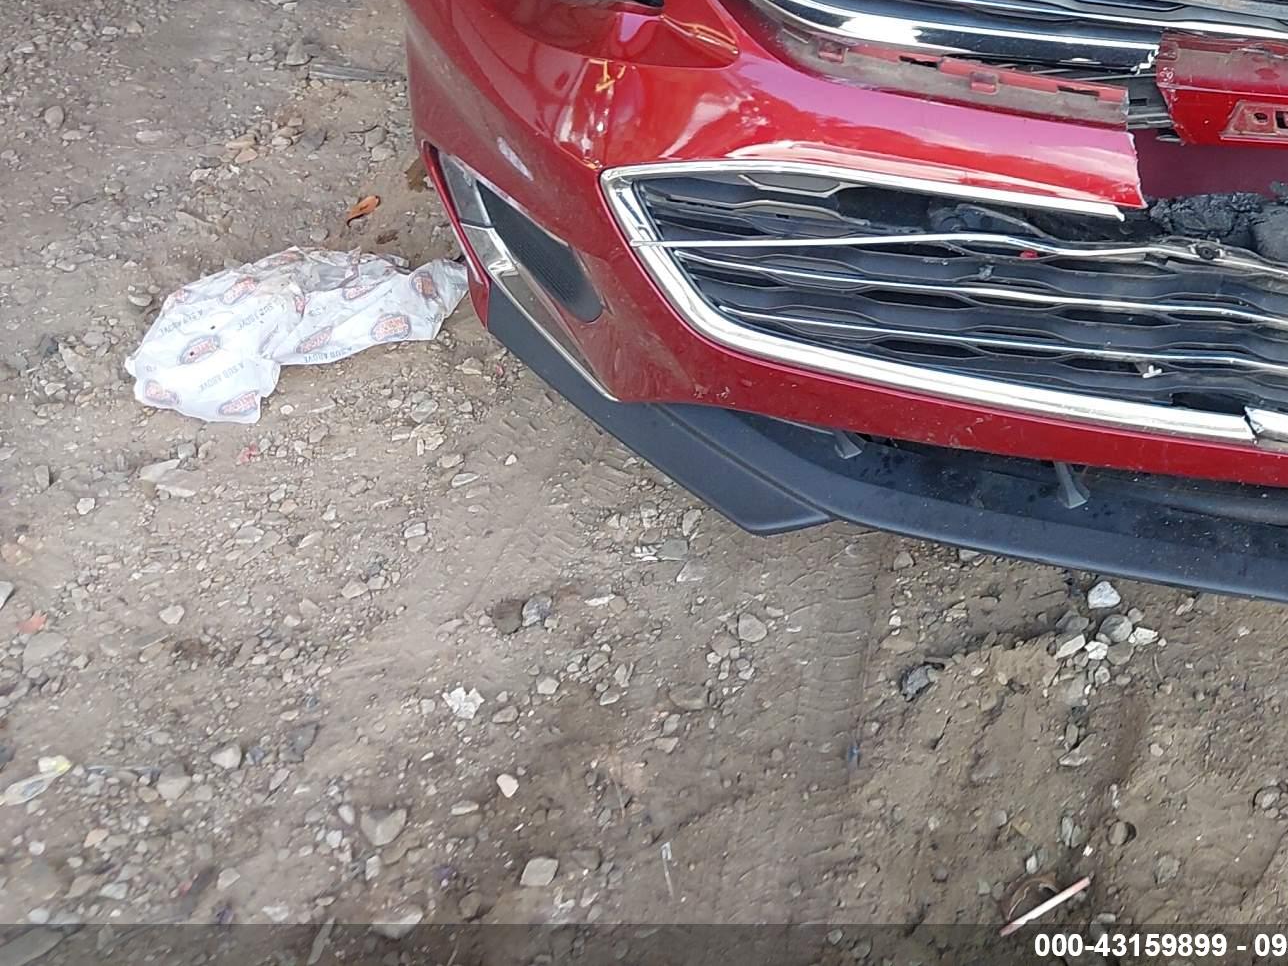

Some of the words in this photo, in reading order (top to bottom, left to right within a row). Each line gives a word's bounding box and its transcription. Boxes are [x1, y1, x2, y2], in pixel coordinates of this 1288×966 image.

[303, 351, 328, 364] ABOVE
[221, 364, 240, 379] SUB
[198, 373, 224, 393] ABOVE
